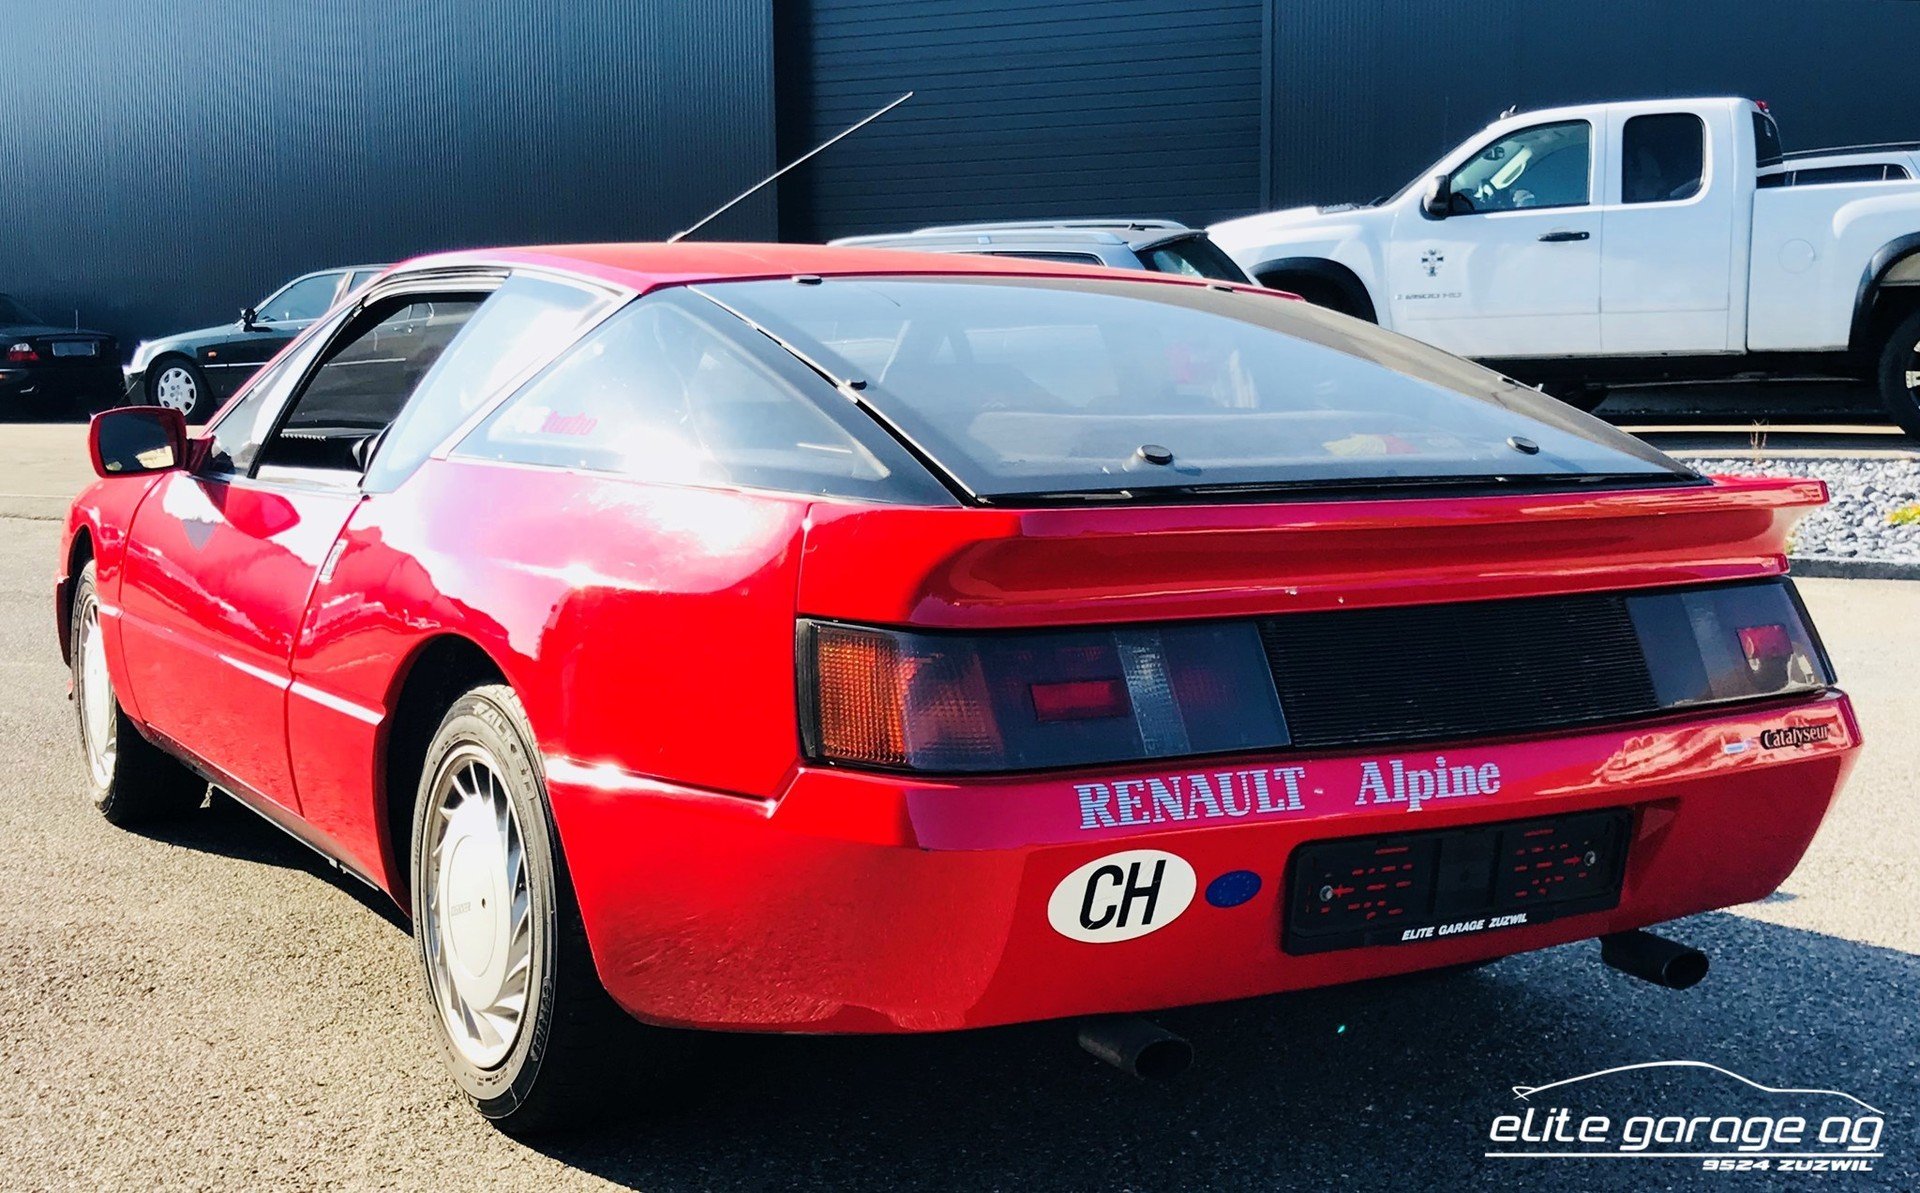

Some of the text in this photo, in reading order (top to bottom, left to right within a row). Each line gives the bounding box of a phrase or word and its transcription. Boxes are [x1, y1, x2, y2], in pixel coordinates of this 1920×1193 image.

[541, 410, 598, 435] turbo
[1762, 726, 1828, 749] Catalyseur
[1073, 756, 1501, 830] RENAULT Alpine
[1079, 858, 1166, 930] CH
[1401, 913, 1528, 941] ELITE GARAGE ZUZWIL
